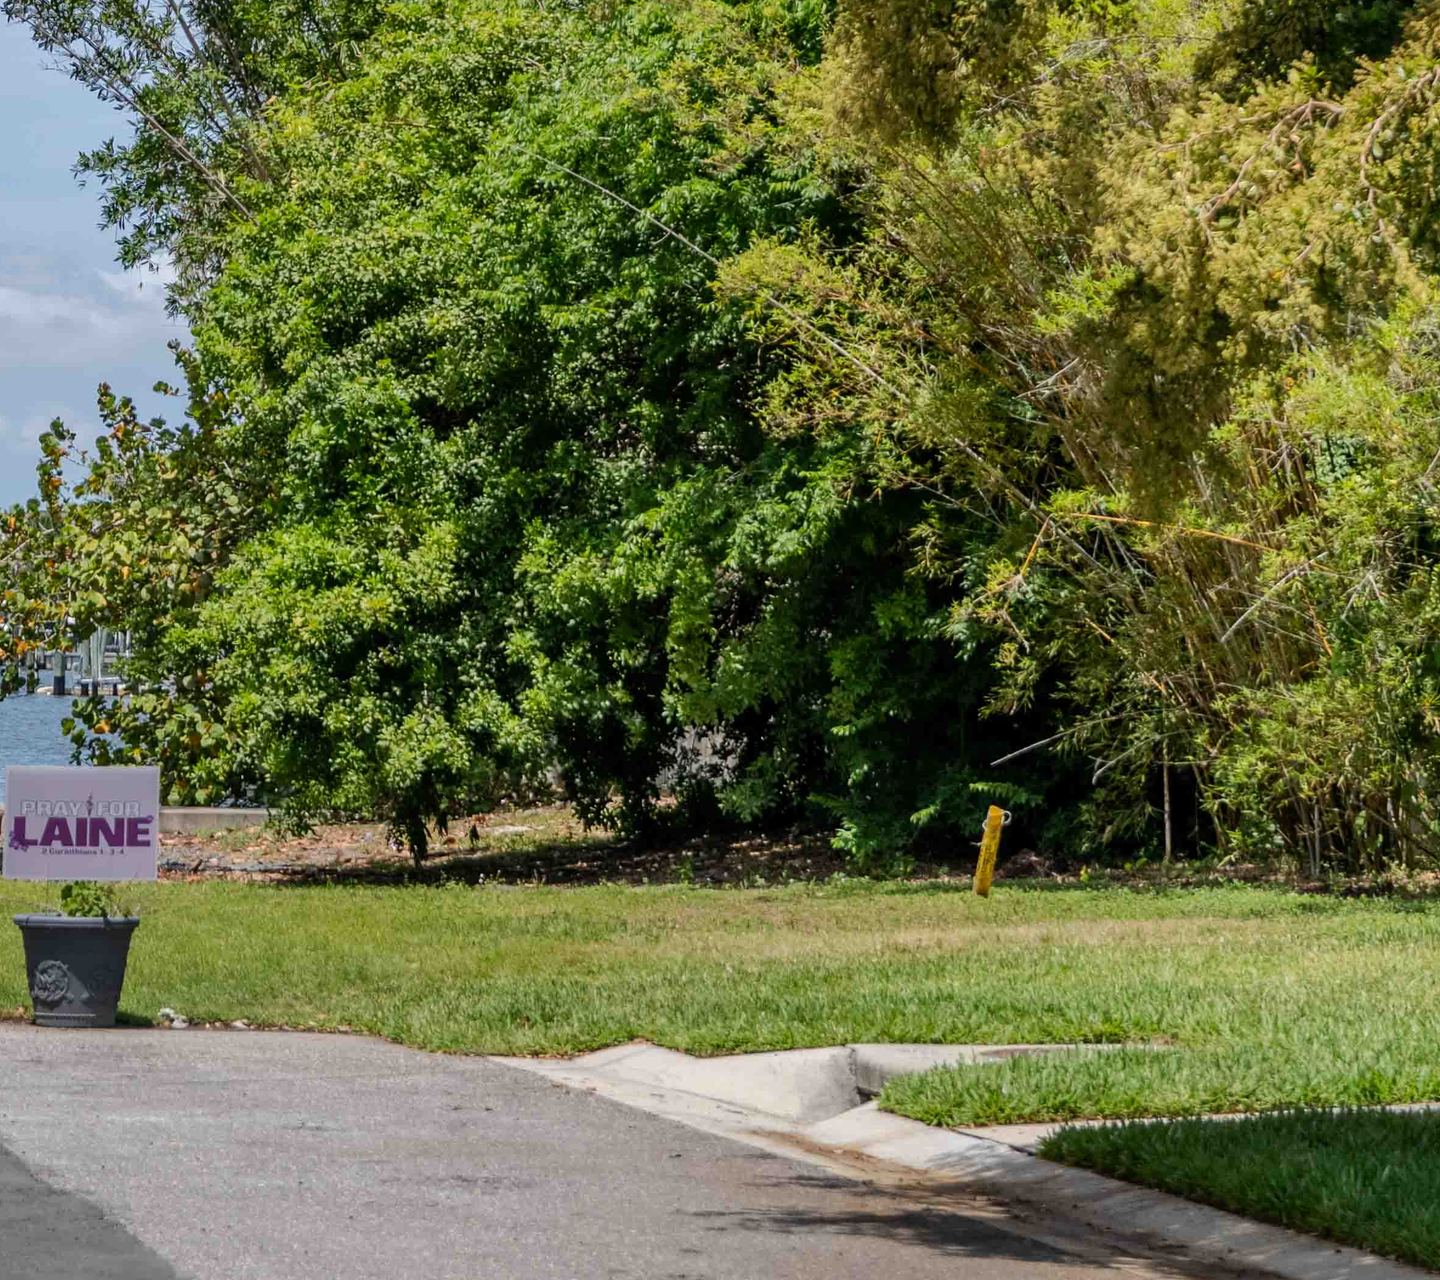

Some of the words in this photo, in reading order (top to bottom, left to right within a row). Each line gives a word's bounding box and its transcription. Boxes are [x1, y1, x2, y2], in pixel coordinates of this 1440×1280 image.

[20, 800, 83, 816] PRAY
[96, 800, 141, 816] FOR
[10, 816, 153, 847] LAINE
